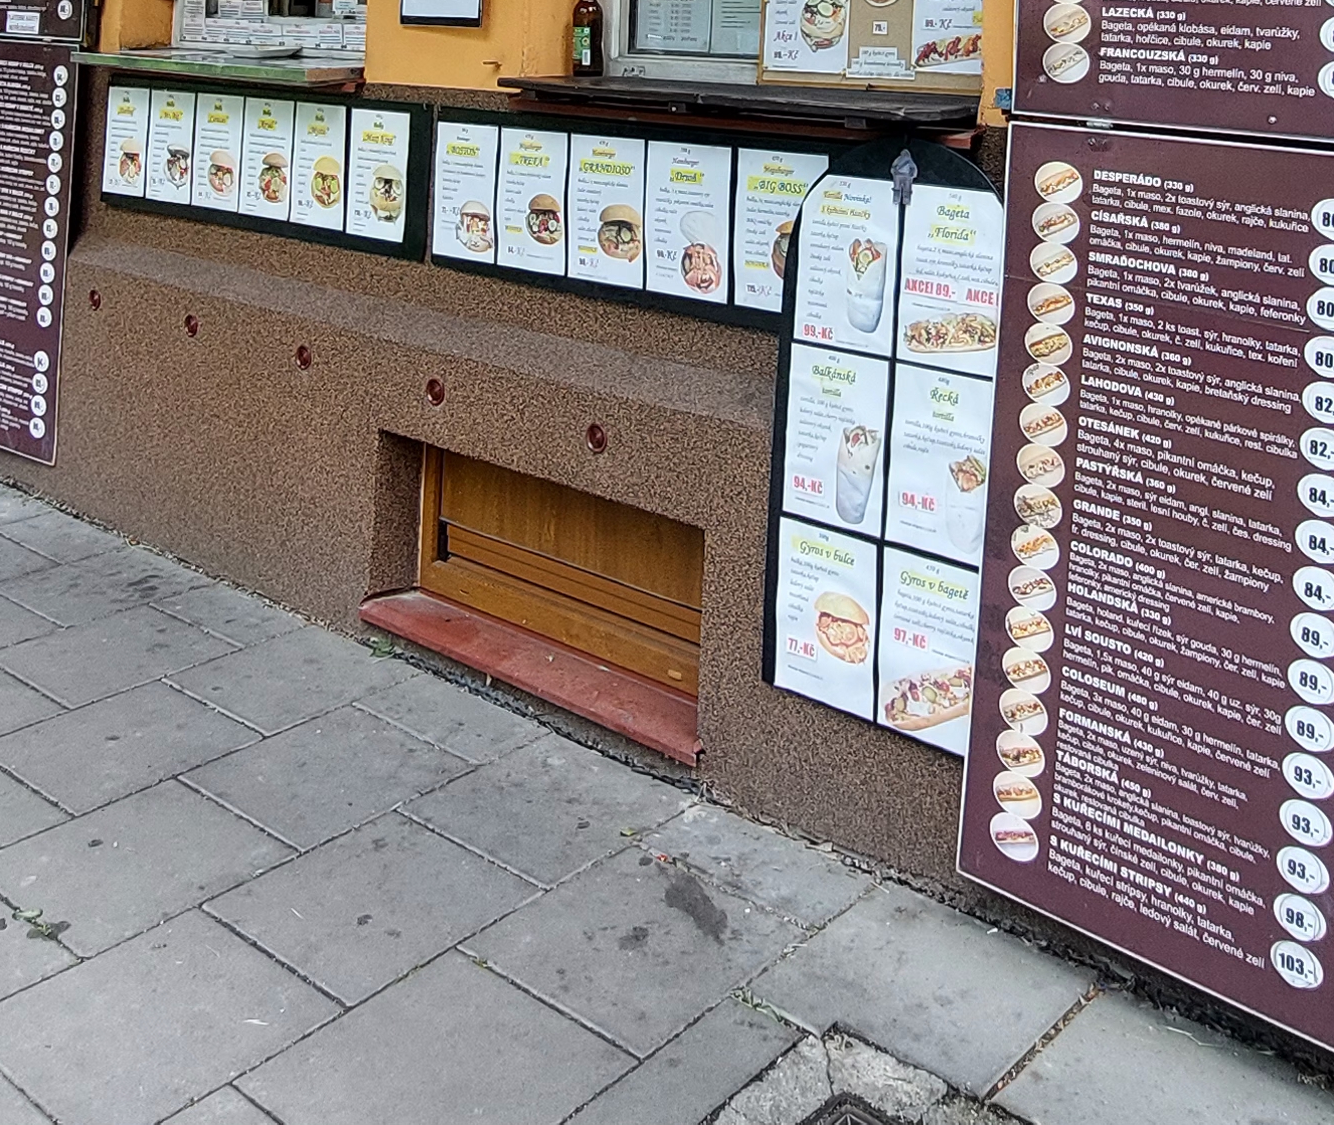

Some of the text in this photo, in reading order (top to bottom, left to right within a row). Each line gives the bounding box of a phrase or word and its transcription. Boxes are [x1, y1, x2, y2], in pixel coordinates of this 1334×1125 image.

[1100, 46, 1185, 63] FRANCOUZSKÁ
[1094, 170, 1161, 188] DESPERÁDO
[937, 205, 969, 220] Bageta
[966, 288, 993, 305] AKCE
[1086, 294, 1122, 310] TEXAS
[1083, 334, 1158, 358] AVIGNONSKÁ
[812, 365, 856, 383] Balkánská
[1080, 375, 1142, 398] LAHODOVA
[930, 387, 958, 405] Řecká
[1078, 416, 1140, 440] OTESÁNEK
[1073, 500, 1120, 521] GRANDE
[800, 541, 824, 557] Gyros
[1070, 541, 1133, 568] COLORADO
[900, 572, 925, 589] Gyros
[937, 579, 968, 600] bagetě
[1062, 667, 1125, 698] COLOSEUM
